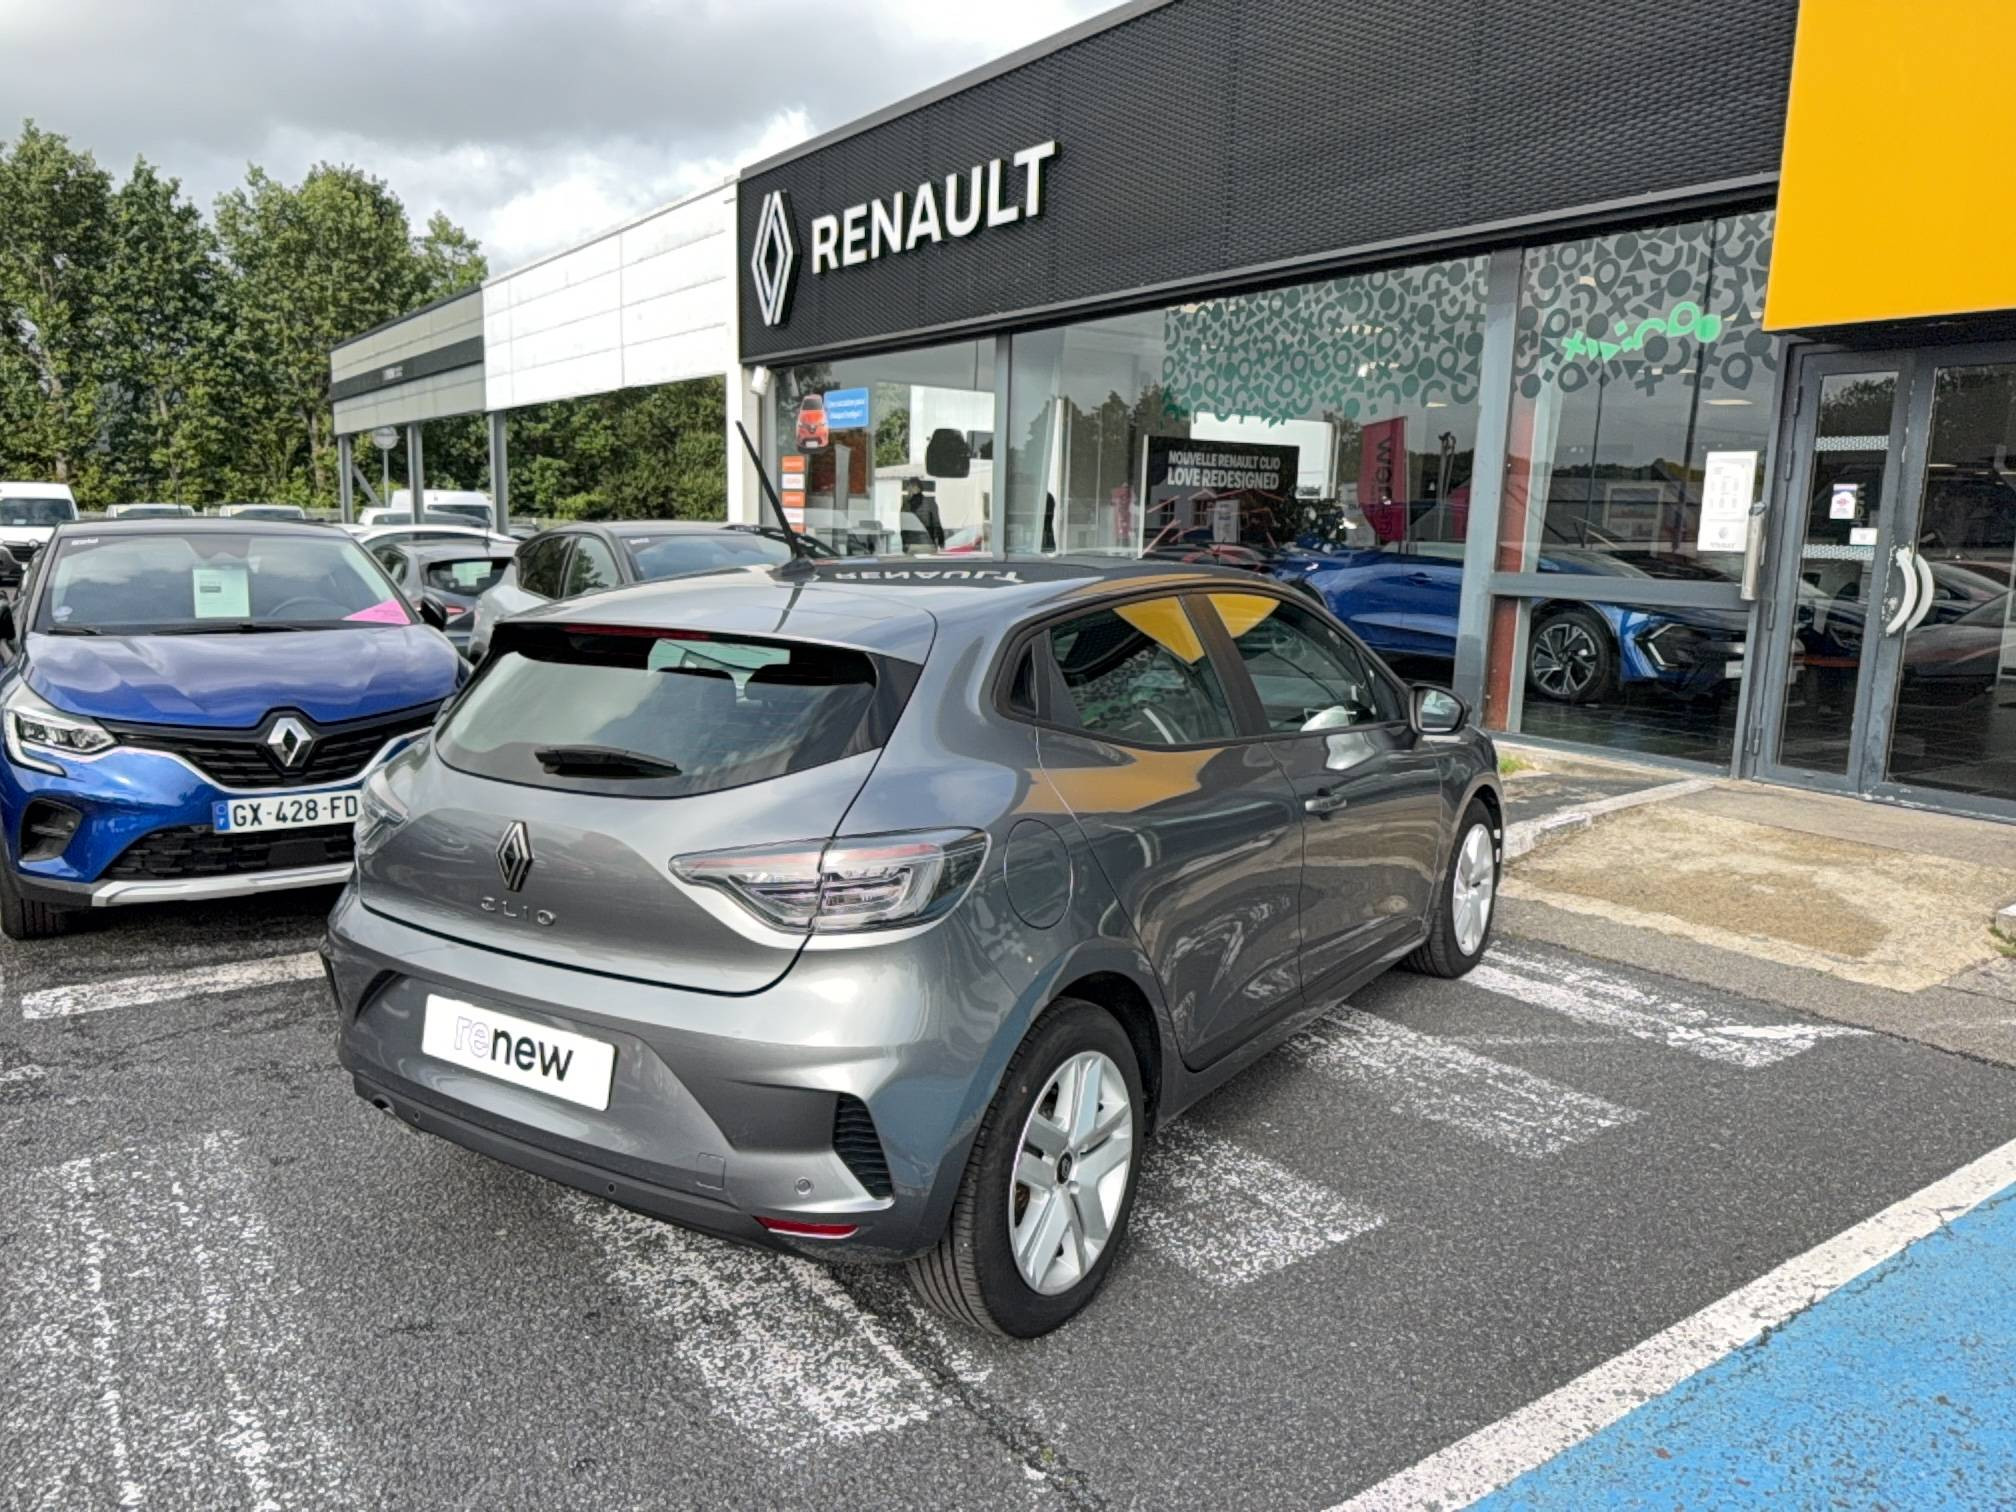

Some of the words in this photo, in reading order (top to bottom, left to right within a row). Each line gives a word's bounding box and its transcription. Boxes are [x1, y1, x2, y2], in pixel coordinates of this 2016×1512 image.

[811, 140, 1058, 275] RENAULT
[1168, 450, 1217, 466] NOUVELLE
[1218, 453, 1259, 469] RENAULT
[1260, 455, 1281, 469] CLIO
[1167, 467, 1201, 487] LOVE
[1202, 470, 1279, 490] REDESIGNED
[232, 795, 358, 827] GX-428-FD
[480, 896, 558, 926] CLIO
[454, 1015, 574, 1082] renew
